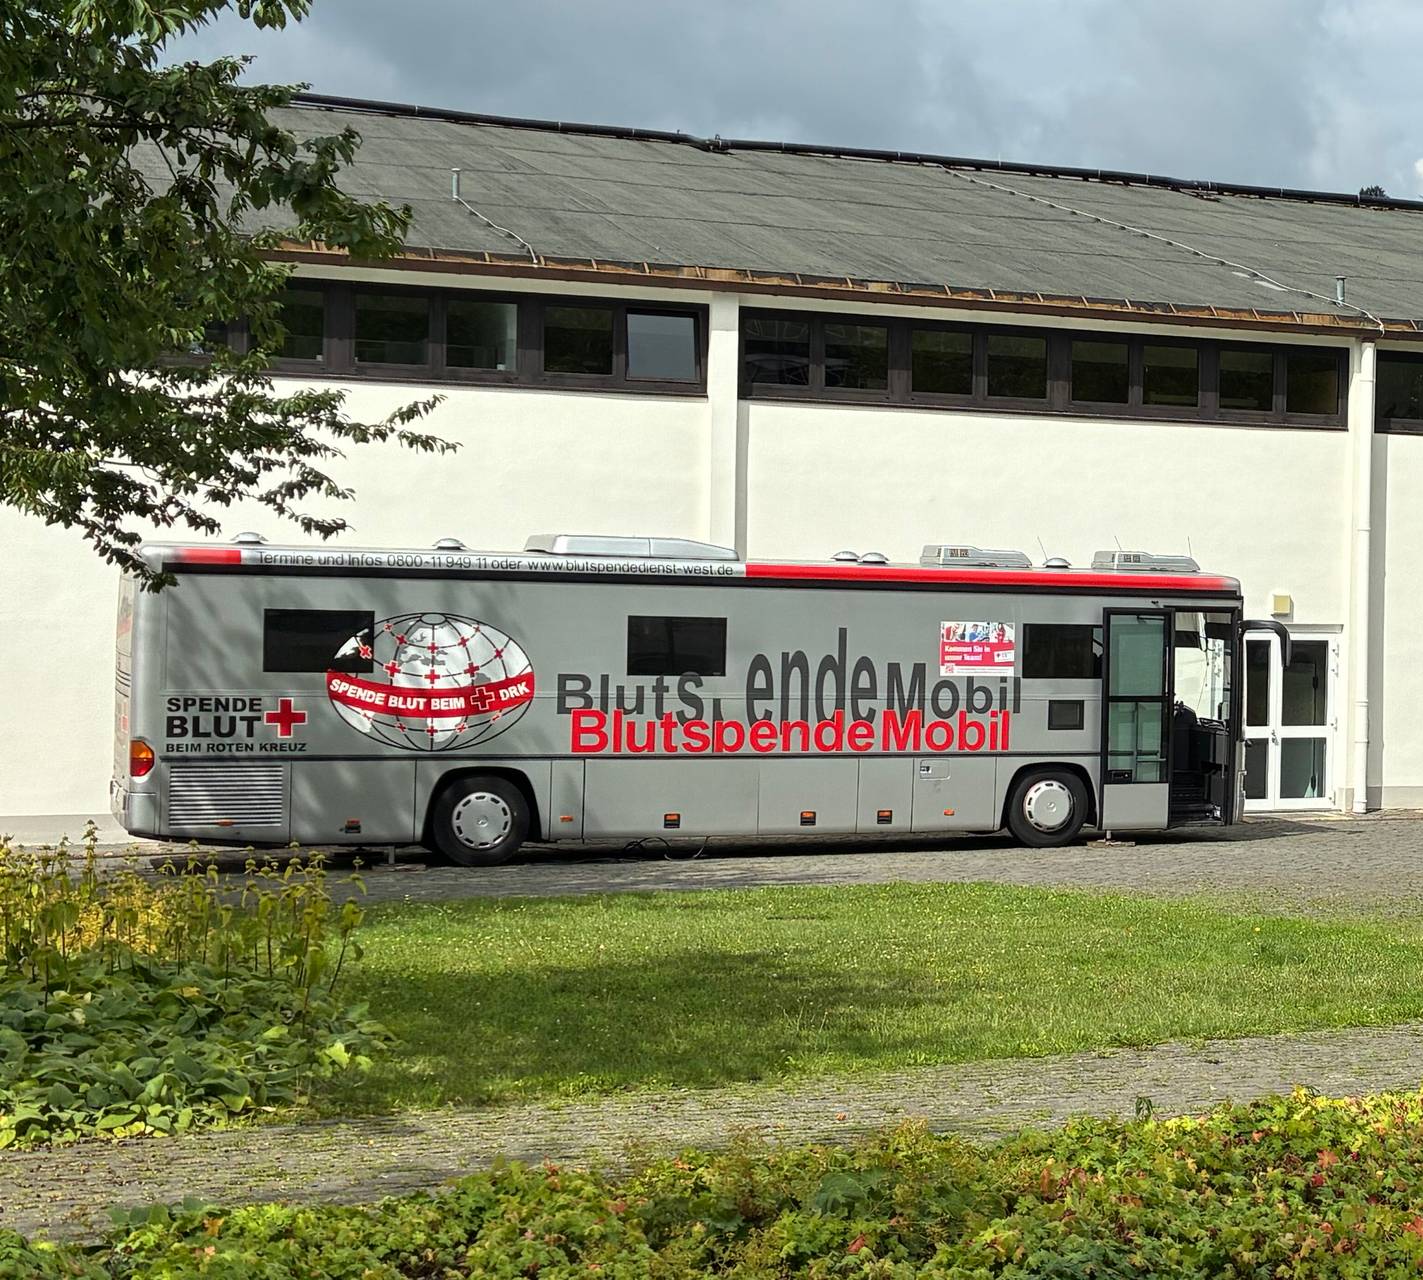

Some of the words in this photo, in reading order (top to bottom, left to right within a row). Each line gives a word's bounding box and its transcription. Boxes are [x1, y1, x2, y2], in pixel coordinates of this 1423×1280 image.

[257, 551, 313, 566] Termine
[318, 553, 344, 567] und
[348, 553, 382, 567] Infos
[446, 556, 471, 569] 949
[477, 556, 488, 569] 11
[491, 557, 522, 570] oder
[528, 559, 734, 576] www.blutspendedienst-west.de
[166, 697, 262, 712] SPENDE
[329, 679, 386, 705] SPENDE
[388, 695, 427, 710] BLUT
[430, 697, 465, 710] BEIM
[498, 681, 530, 701] DRK
[165, 715, 262, 738] BLUT
[165, 743, 201, 752] BEIM
[206, 743, 254, 752] ROTEN
[259, 743, 307, 752] KREUZ
